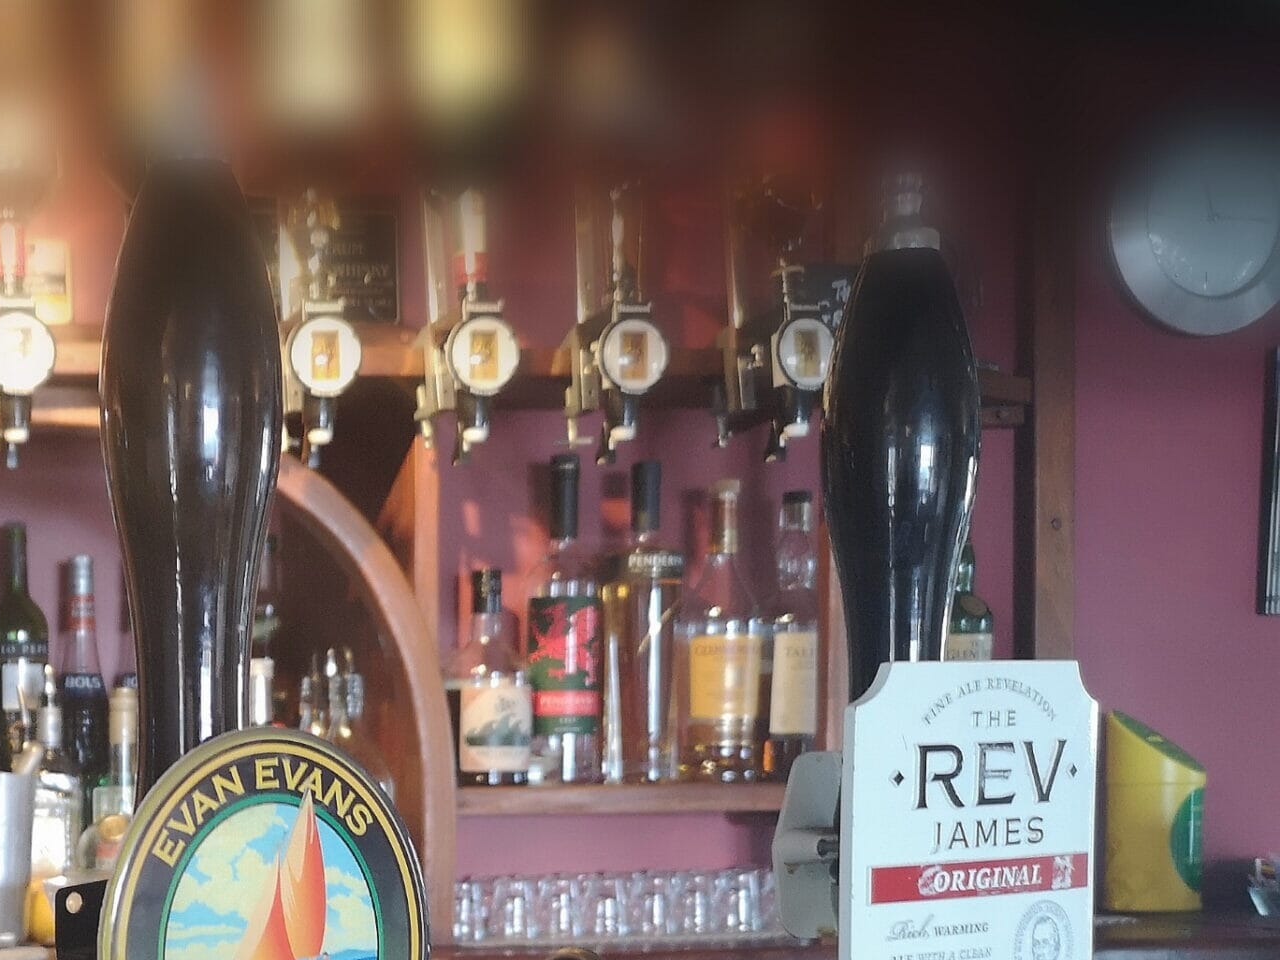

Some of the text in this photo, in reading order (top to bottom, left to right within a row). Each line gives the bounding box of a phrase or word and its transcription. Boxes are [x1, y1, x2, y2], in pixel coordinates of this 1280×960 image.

[922, 677, 1057, 725] FINE ALE REVELATION
[971, 710, 1017, 728] THE
[912, 739, 1068, 810] REV
[151, 756, 374, 868] EVAN EVANS
[930, 816, 1045, 855] JAMES
[932, 863, 1043, 893] ORIGINAL
[934, 922, 990, 937] WARMING
[959, 947, 993, 960] CLEAN
